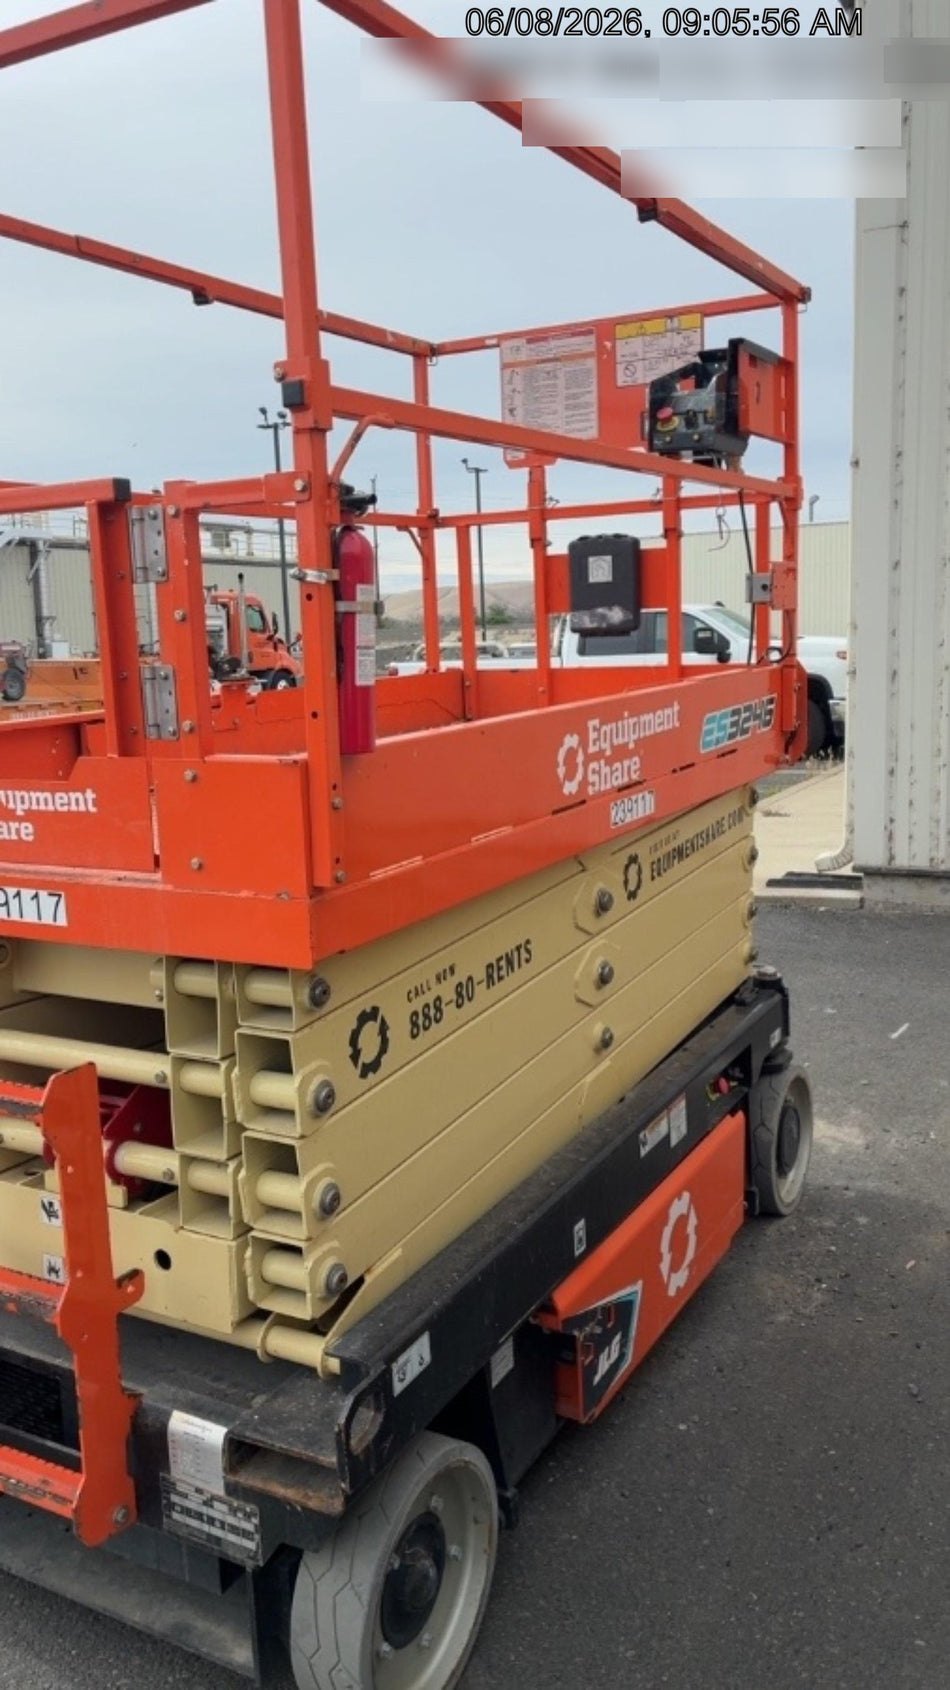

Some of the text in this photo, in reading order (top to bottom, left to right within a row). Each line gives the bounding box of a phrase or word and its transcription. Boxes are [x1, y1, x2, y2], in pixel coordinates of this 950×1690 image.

[587, 700, 681, 755] Equipment
[701, 694, 776, 753] ES3246
[587, 755, 641, 796] Share
[612, 790, 654, 826] 239117
[650, 806, 744, 881] EQUIPMENTSHARE.COM
[406, 979, 432, 1004] CALL
[408, 938, 533, 1040] 888-80-RENTS
[592, 1331, 622, 1387] JLG
